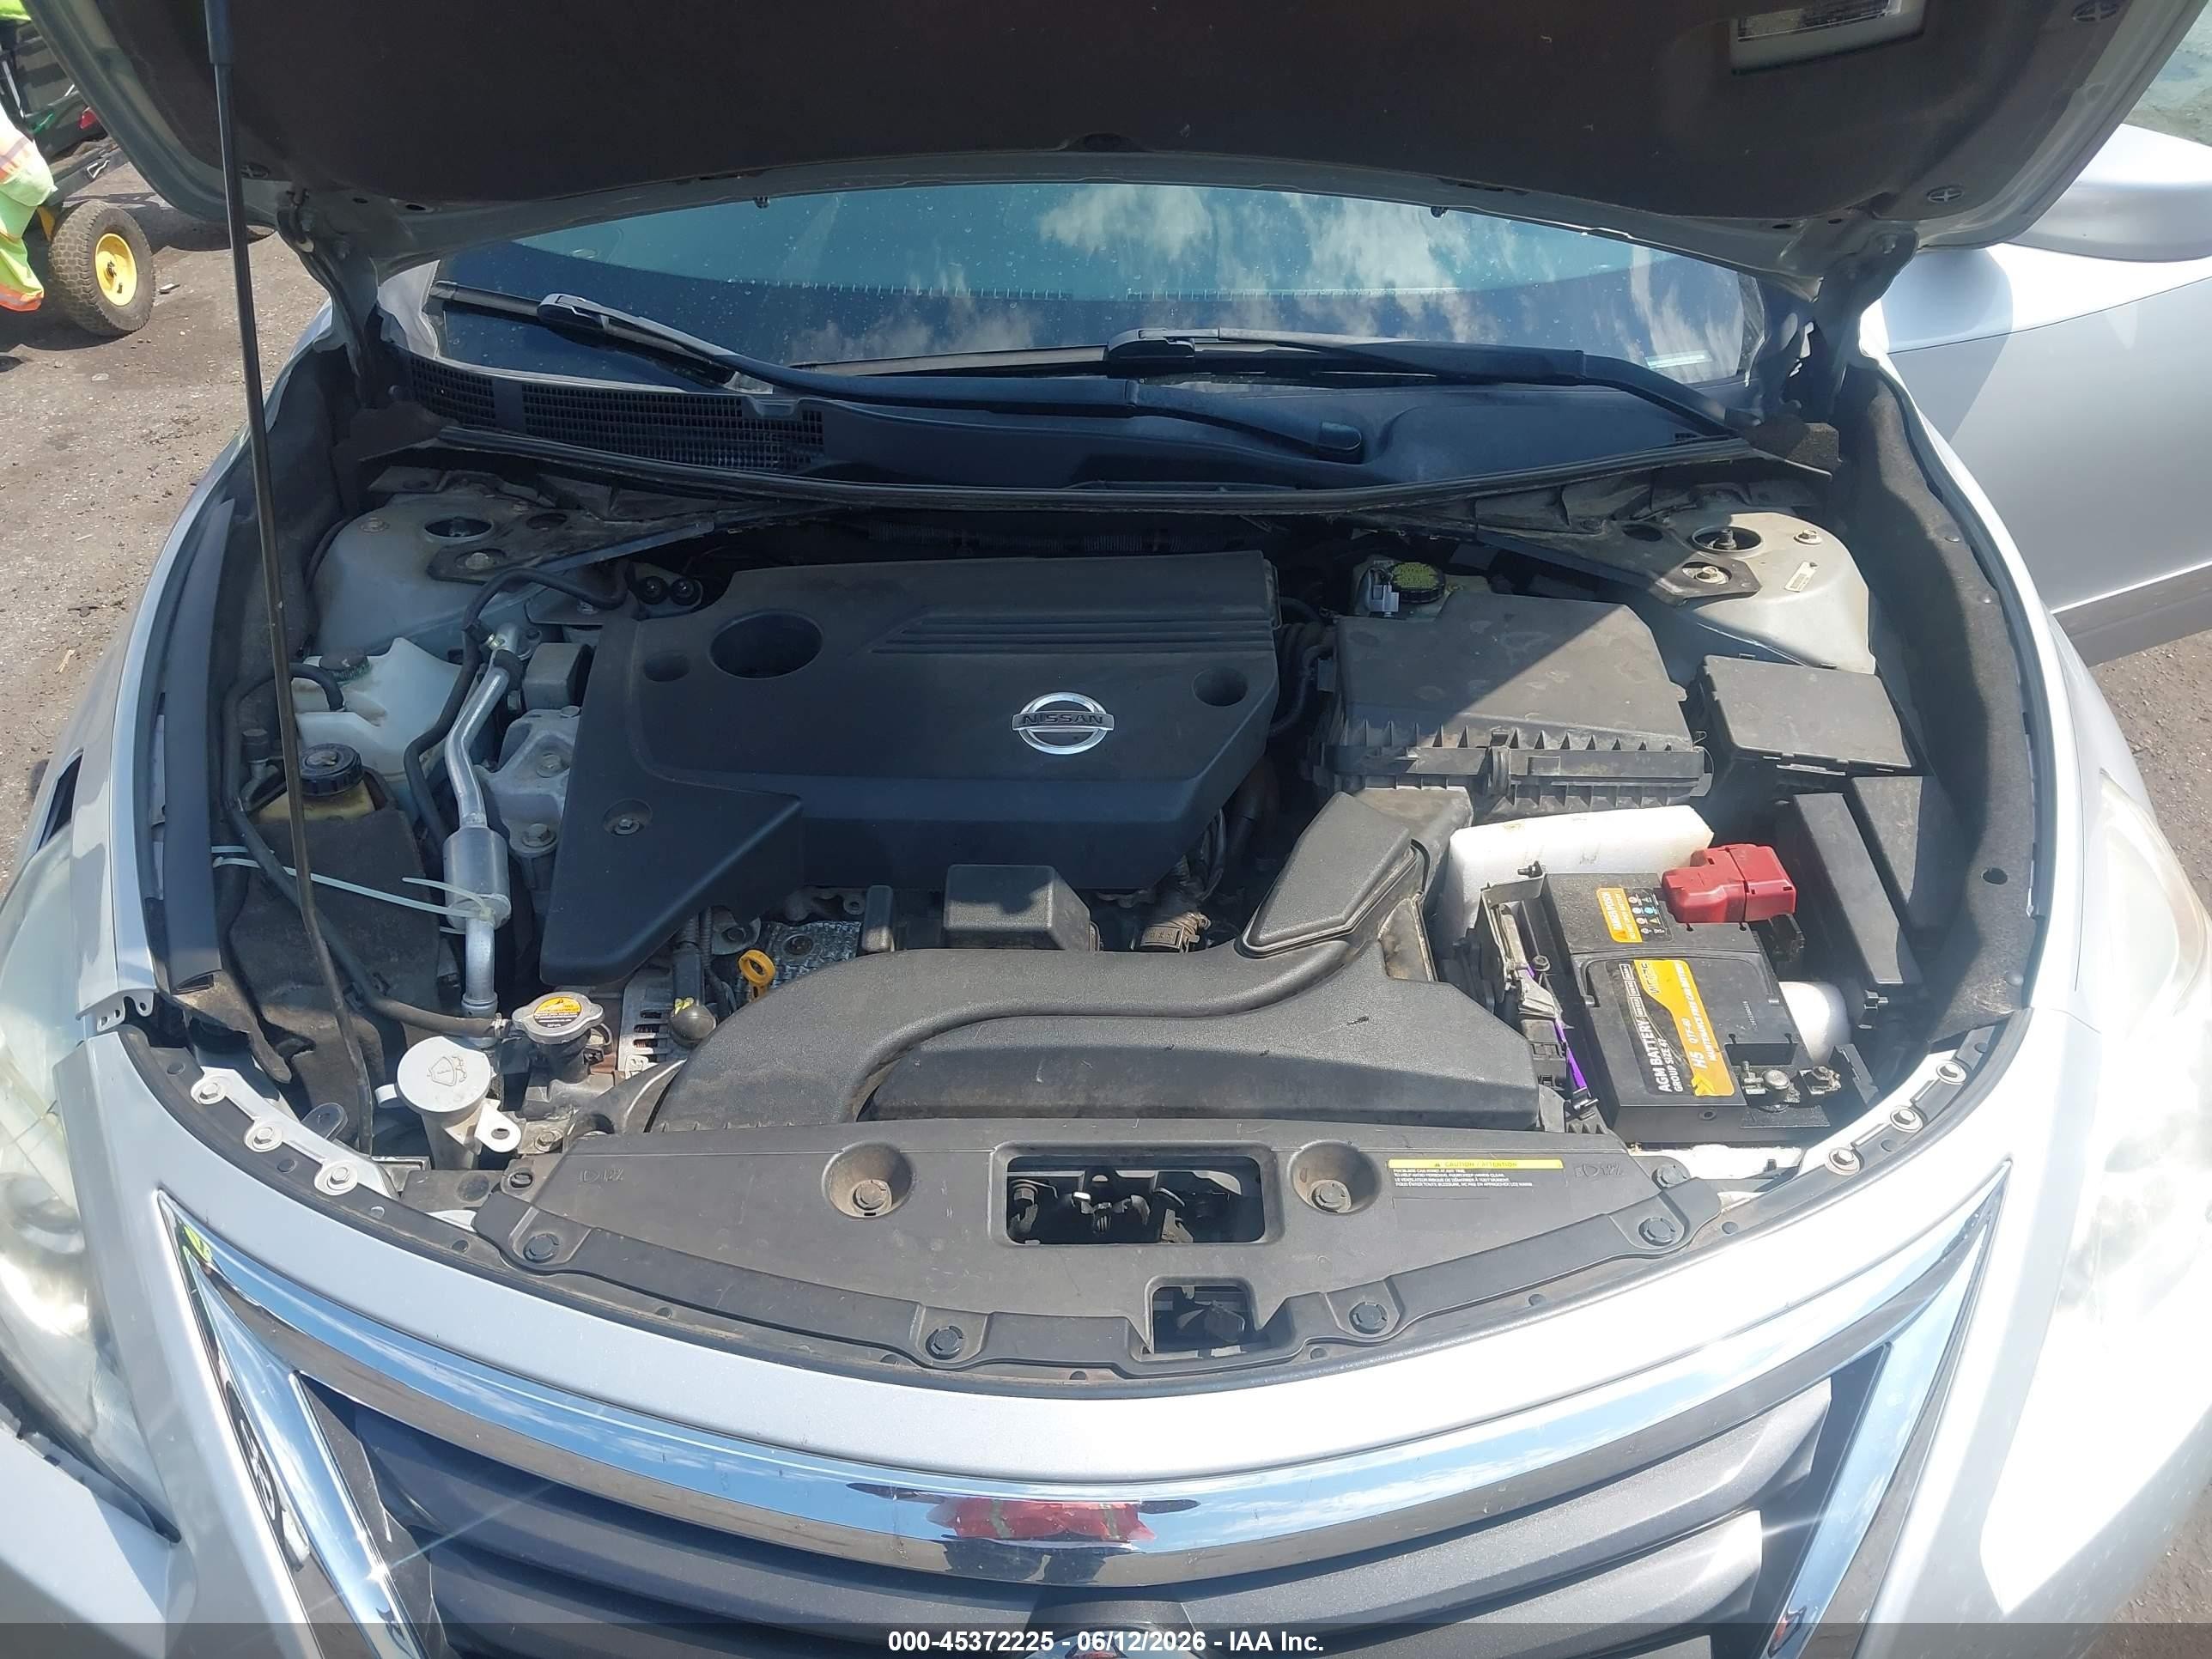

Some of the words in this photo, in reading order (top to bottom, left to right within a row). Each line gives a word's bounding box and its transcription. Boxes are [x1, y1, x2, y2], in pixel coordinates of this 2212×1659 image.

[1022, 714, 1103, 724] NISSAN
[1685, 988, 1695, 1000] CAR
[1689, 1001, 1700, 1018] FREE
[1635, 1019, 1663, 1065] BATTERY
[1657, 1038, 1668, 1048] 47
[1694, 1018, 1717, 1061] MAINTENANCE
[1661, 1048, 1674, 1064] SIZE
[1689, 1051, 1707, 1068] H5
[1652, 1067, 1673, 1092] AGM
[1667, 1064, 1683, 1092] GROUP
